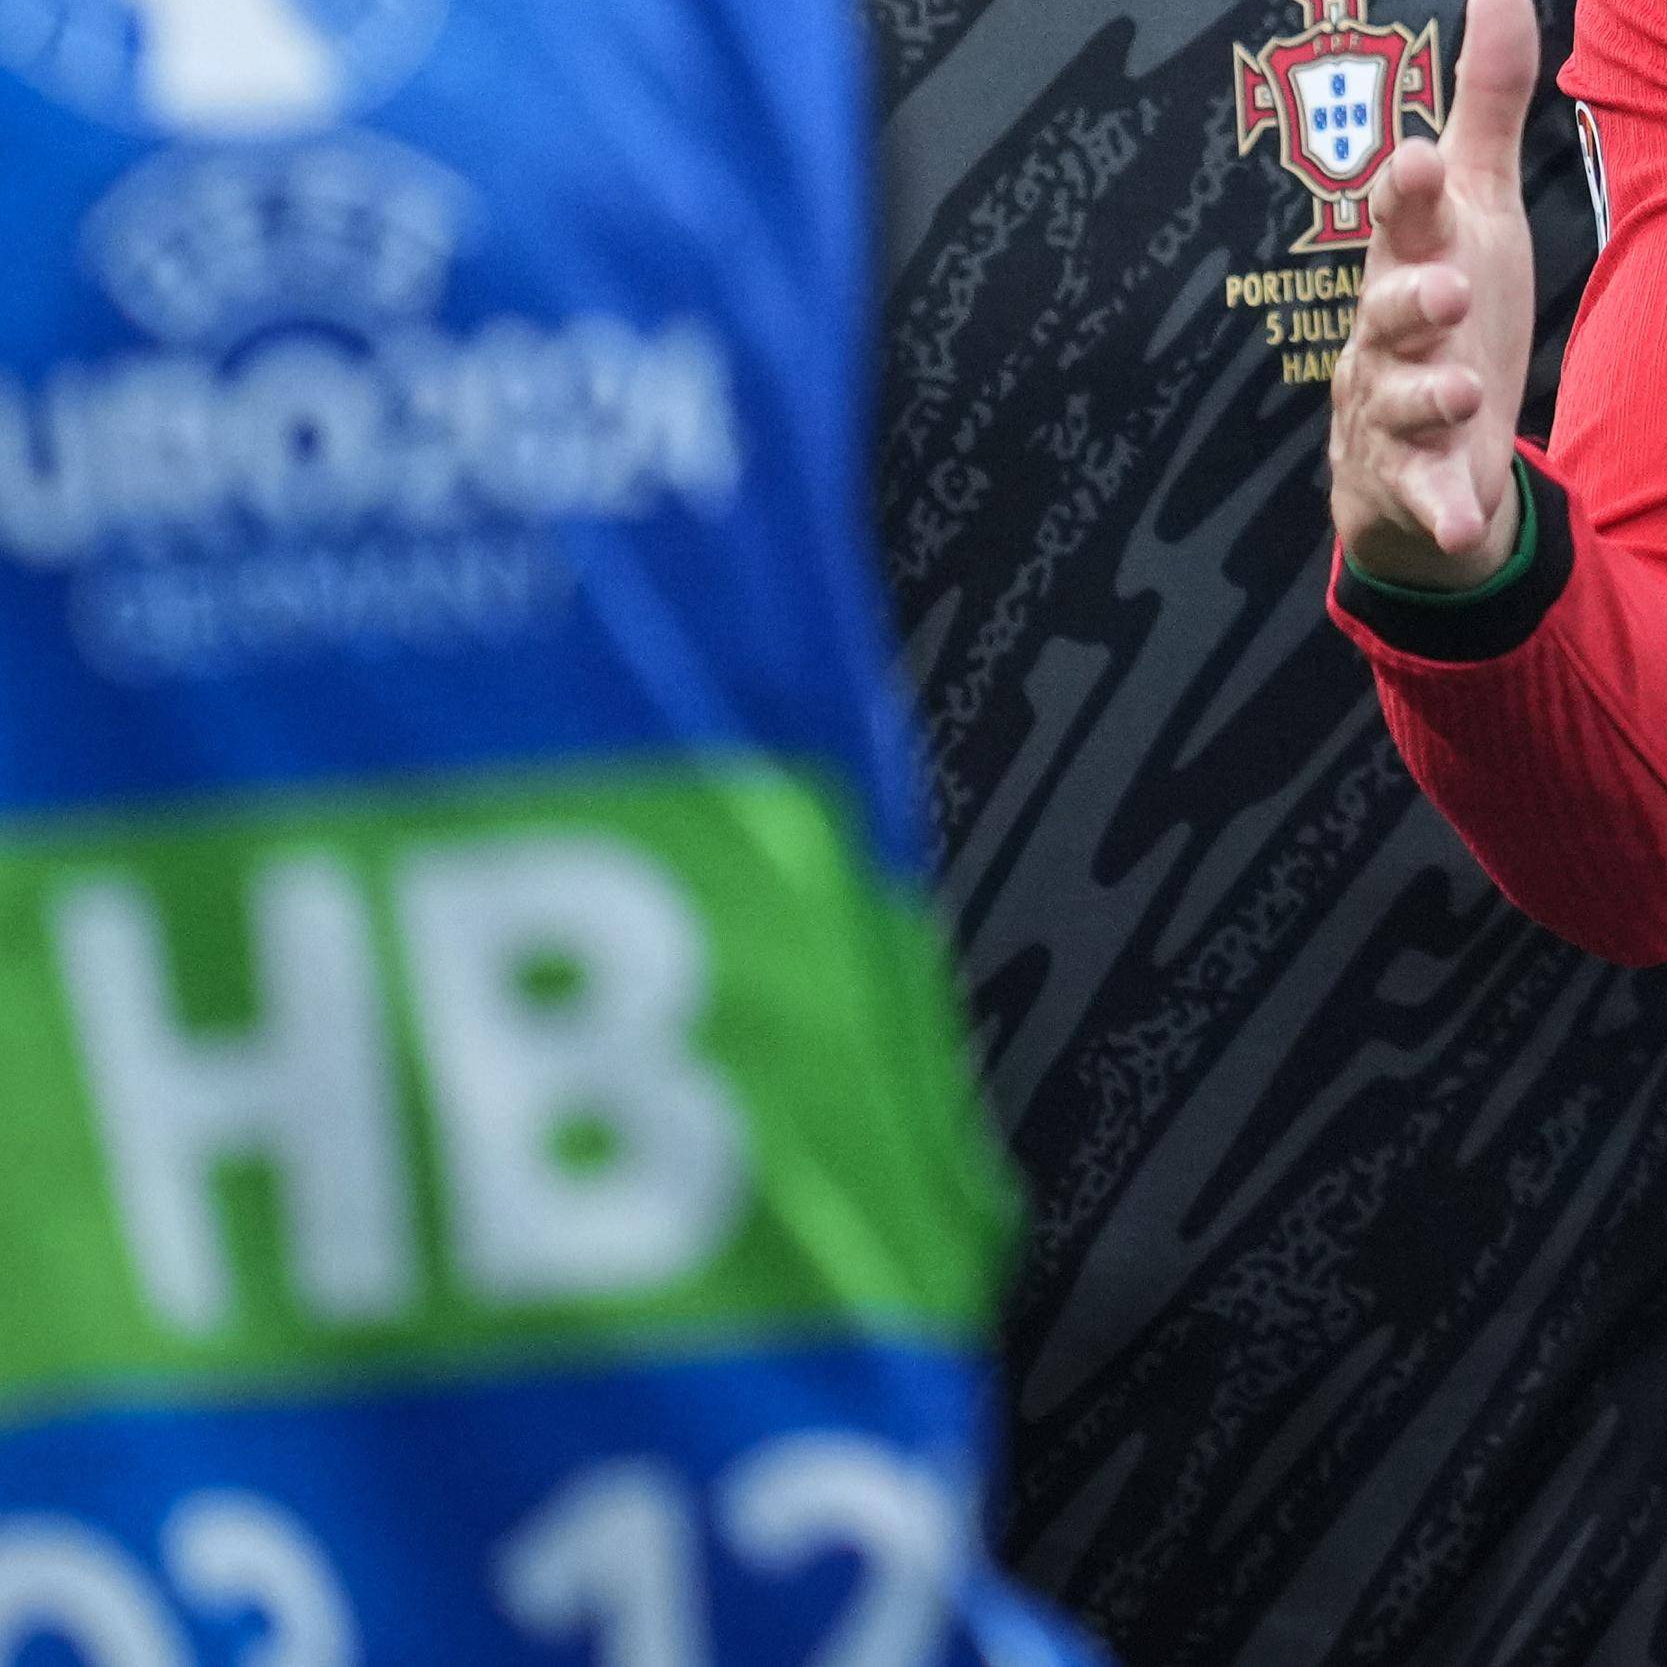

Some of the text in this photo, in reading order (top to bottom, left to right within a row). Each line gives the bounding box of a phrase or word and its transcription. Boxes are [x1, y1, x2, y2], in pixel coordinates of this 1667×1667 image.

[1266, 307, 1357, 346] 5 JULH
[55, 821, 755, 1339] HB
